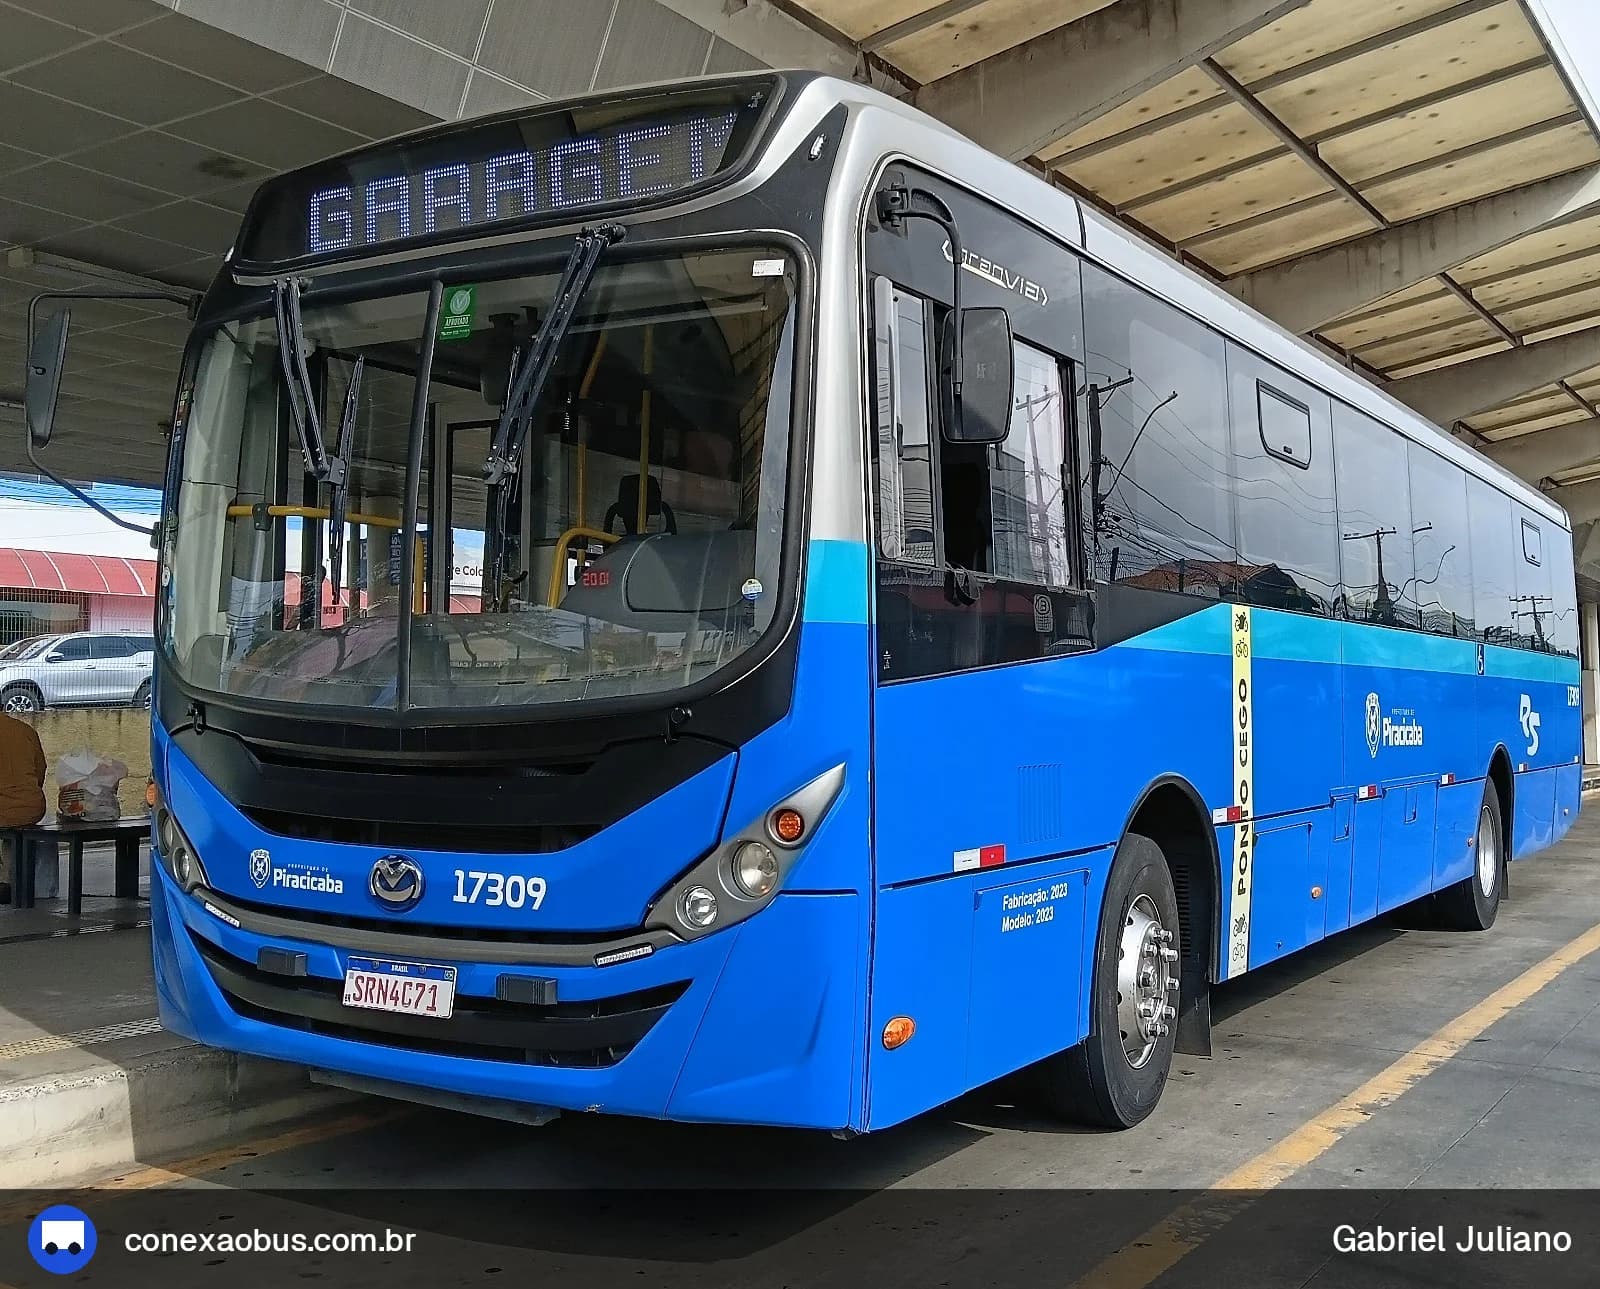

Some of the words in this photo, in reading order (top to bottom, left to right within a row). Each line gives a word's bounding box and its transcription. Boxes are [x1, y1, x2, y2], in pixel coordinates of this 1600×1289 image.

[1238, 678, 1248, 767] CEGO
[273, 868, 344, 894] Piracicaba
[452, 869, 547, 911] 17309
[1002, 887, 1049, 912] Fabricação:
[1050, 882, 1068, 900] 2023
[1001, 911, 1034, 933] Modelo:
[1035, 905, 1054, 924] 2023
[391, 964, 409, 973] BRASIL
[352, 975, 438, 1012] SRN4C71
